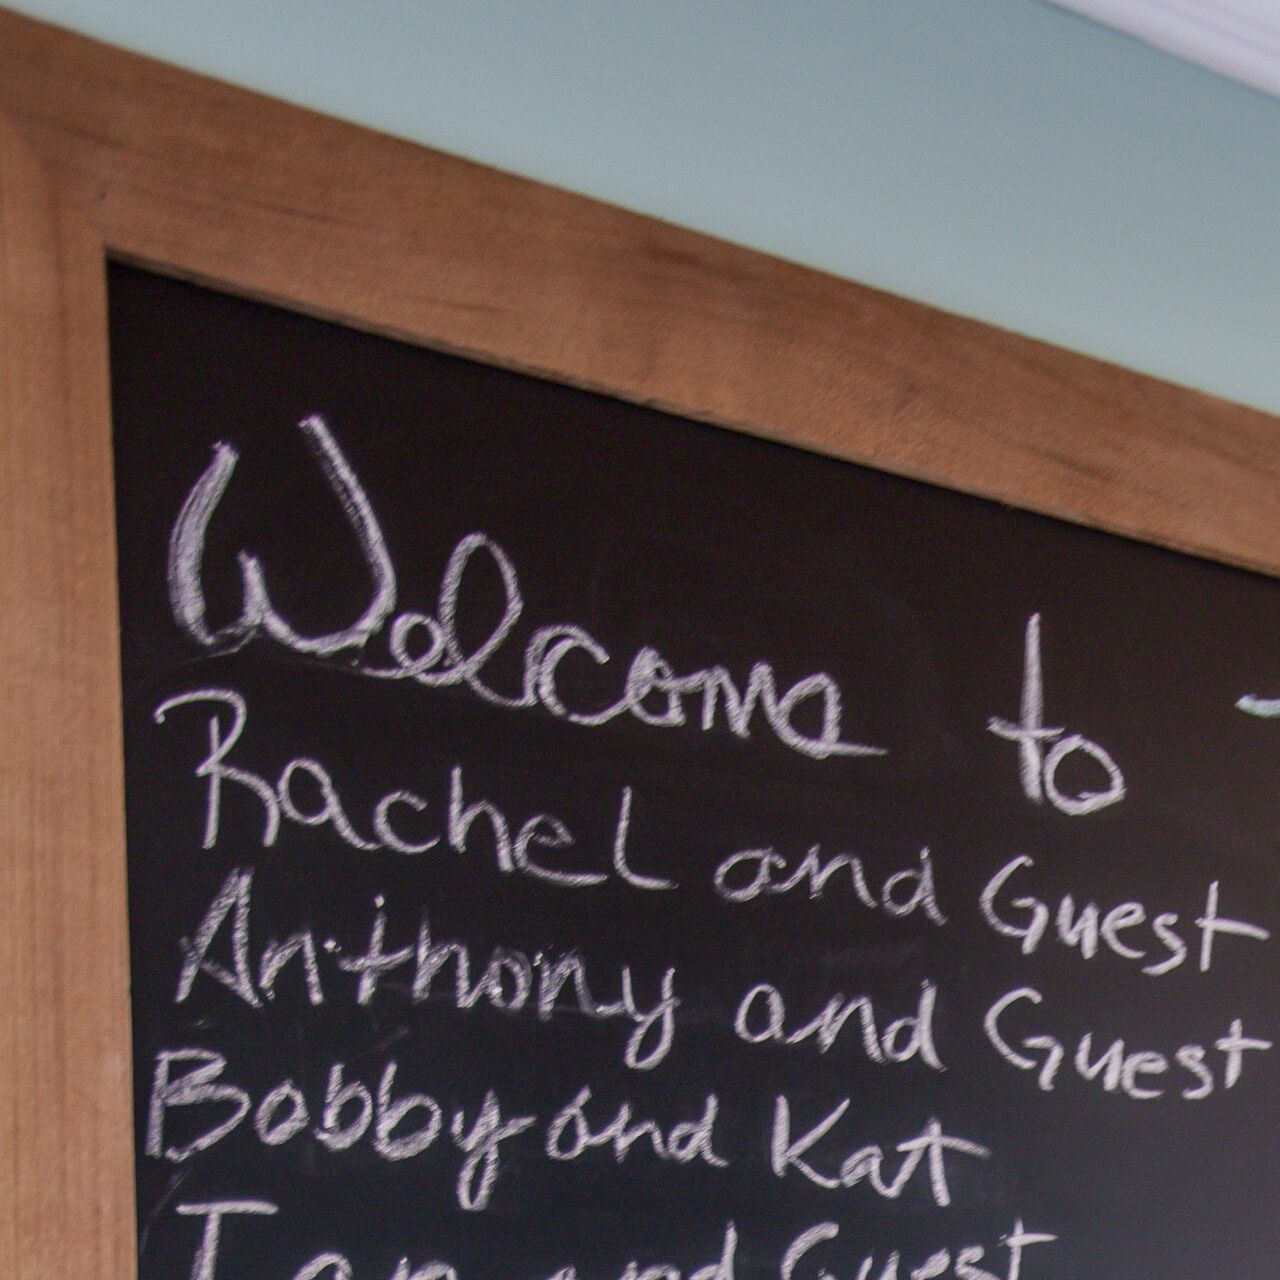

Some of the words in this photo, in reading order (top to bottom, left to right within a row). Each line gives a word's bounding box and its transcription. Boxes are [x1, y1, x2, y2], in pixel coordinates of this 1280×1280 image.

[168, 414, 888, 760] Welcome
[987, 612, 1126, 816] to
[154, 688, 680, 892] Rachel
[714, 844, 948, 926] and
[979, 855, 1270, 976] Guest
[173, 868, 680, 1070] Anthony
[733, 978, 946, 1073] and
[982, 987, 1273, 1100] Guest
[145, 1048, 537, 1212] Bobby
[545, 1086, 728, 1168] and
[771, 1094, 992, 1206] Kat
